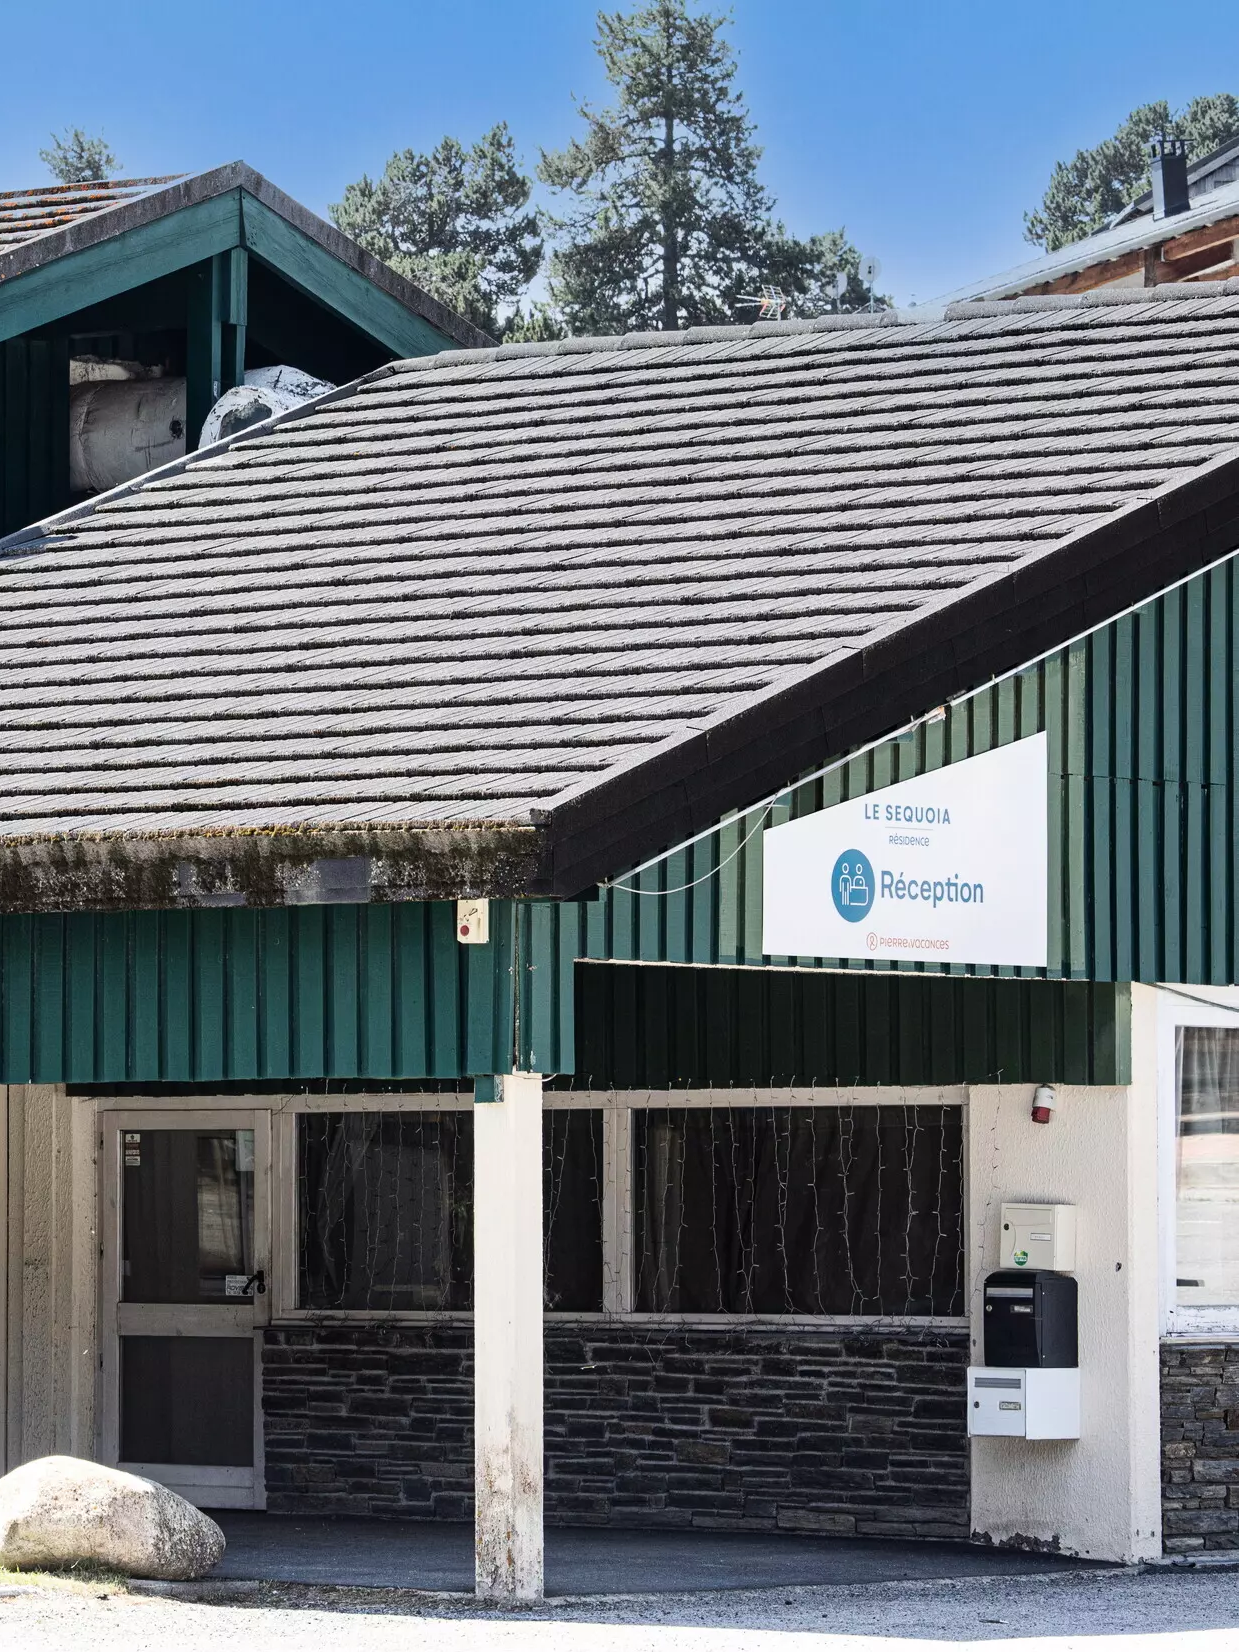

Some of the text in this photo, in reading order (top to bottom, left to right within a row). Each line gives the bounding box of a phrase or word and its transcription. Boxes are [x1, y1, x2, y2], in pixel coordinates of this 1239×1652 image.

[865, 803, 951, 824] LE SEQUOIA
[880, 870, 984, 908] Réception
